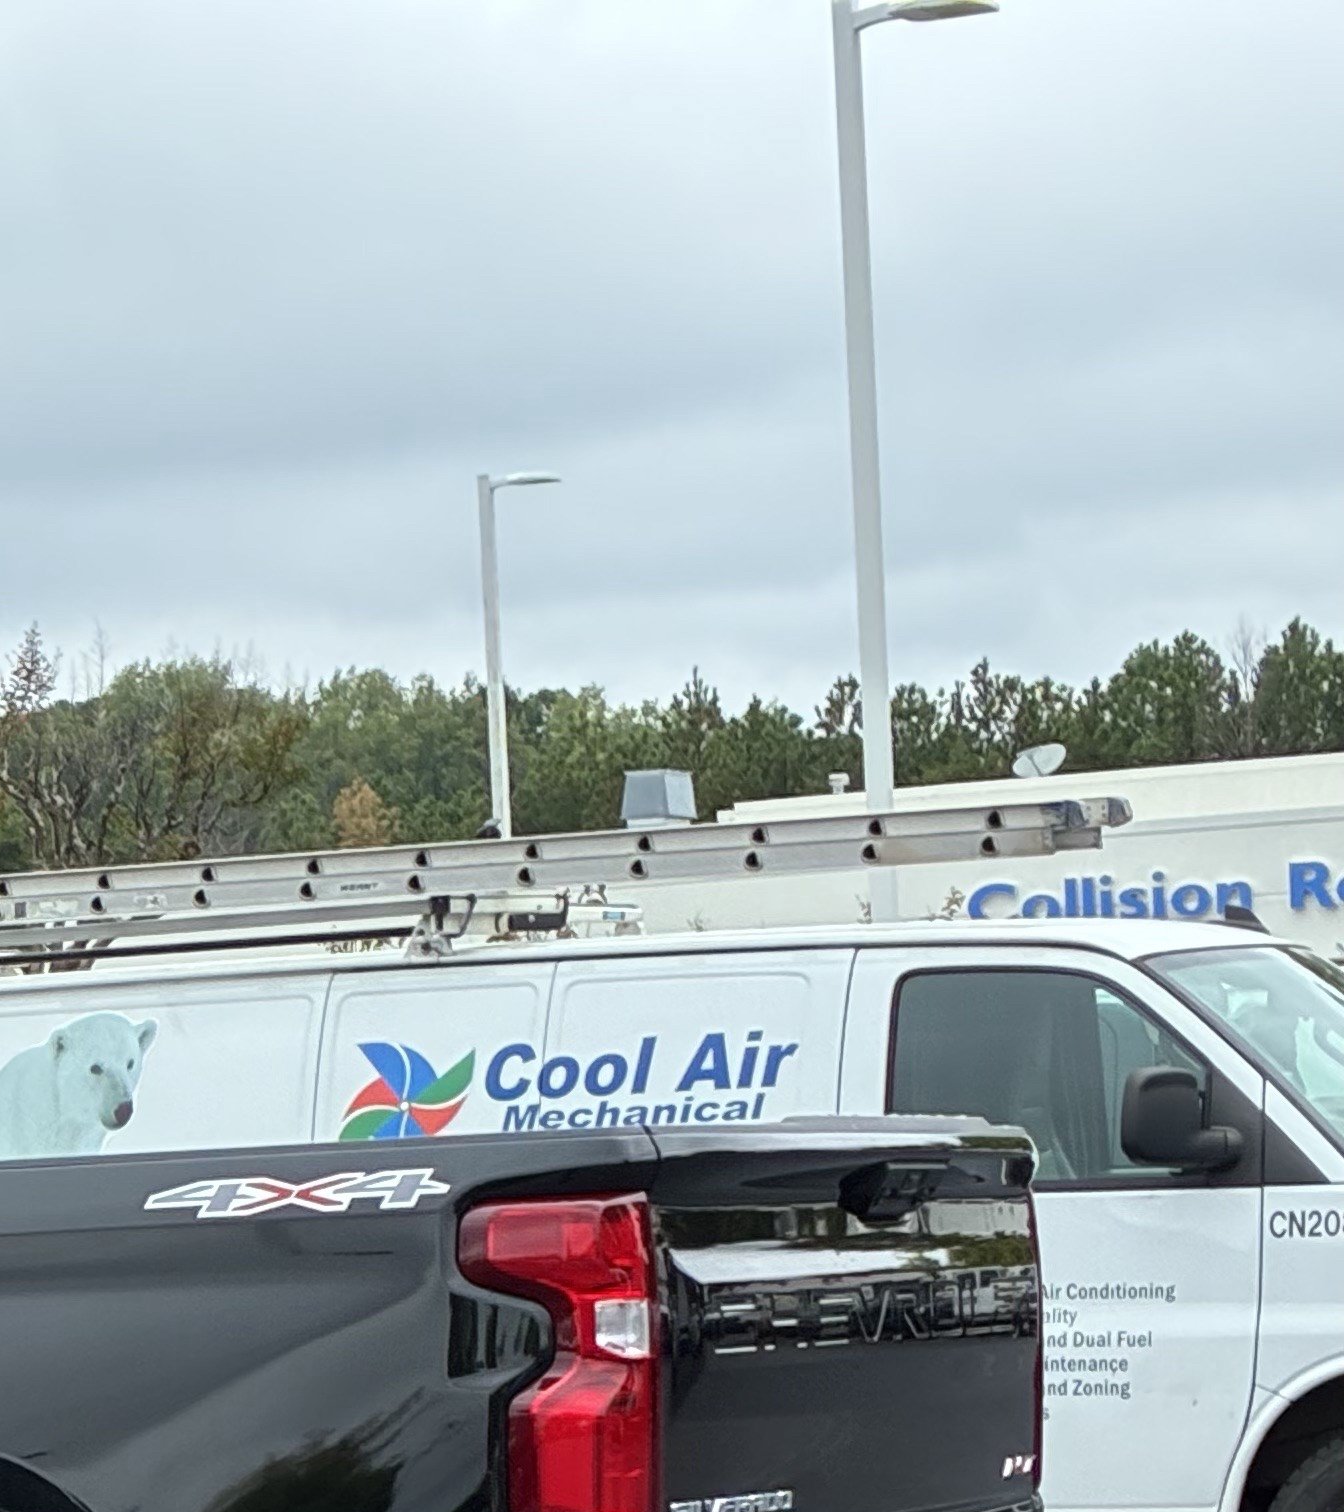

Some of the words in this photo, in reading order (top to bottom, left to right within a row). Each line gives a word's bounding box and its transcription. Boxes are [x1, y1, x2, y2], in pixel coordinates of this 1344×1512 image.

[968, 871, 1252, 919] Collision
[1288, 862, 1344, 910] R
[485, 1036, 657, 1101] Cool
[675, 1030, 800, 1092] Air
[502, 1092, 765, 1131] Mechanical
[1269, 1209, 1344, 1238] CN20
[1066, 1282, 1176, 1303] Conditioning
[1046, 1332, 1067, 1348] nd
[1073, 1331, 1112, 1348] Dual
[1117, 1331, 1152, 1348] Fuel
[1044, 1356, 1128, 1373] intenance
[1043, 1379, 1068, 1396] nd
[1072, 1378, 1131, 1400] Zoning
